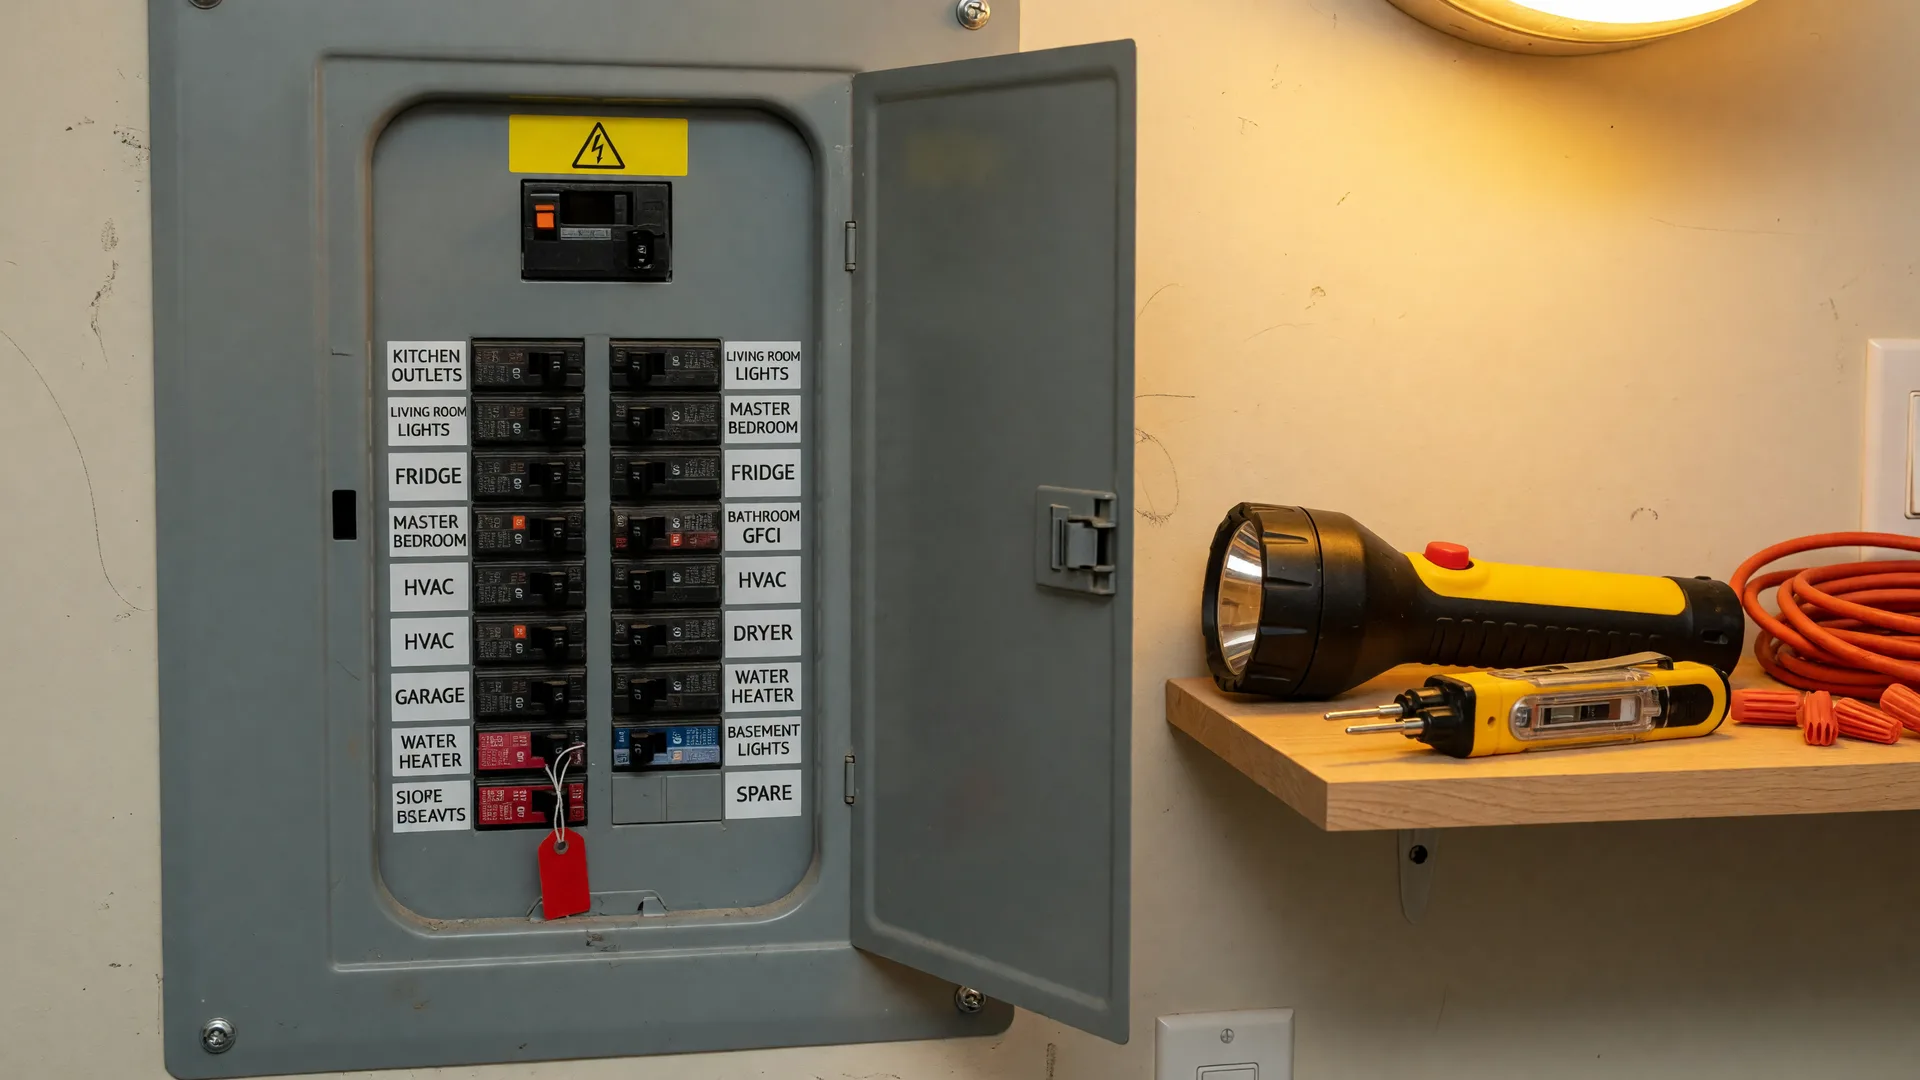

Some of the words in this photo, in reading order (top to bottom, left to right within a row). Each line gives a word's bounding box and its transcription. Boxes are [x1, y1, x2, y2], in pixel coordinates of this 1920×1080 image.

[394, 350, 459, 363] KITCHEN
[727, 351, 764, 361] LIVING
[768, 351, 801, 361] ROOM
[392, 368, 462, 382] OUTLETS
[736, 367, 788, 380] LIGHTS
[391, 407, 430, 417] LIVING
[434, 407, 467, 417] ROOM
[731, 402, 790, 415] MASTER
[399, 423, 449, 436] LIGHTS
[729, 421, 797, 434] BEDROOM
[396, 468, 461, 484] FRIDGE
[732, 464, 794, 480] FRIDGE
[394, 515, 458, 529] MASTER
[728, 511, 800, 522] BATHROOM
[394, 534, 466, 548] BEDROOM
[743, 528, 780, 543] GFCI
[405, 578, 454, 595] HVAC
[739, 571, 786, 588] HVAC
[734, 624, 793, 641] DRYER
[405, 632, 454, 650] HVAC
[735, 669, 789, 684] WATER
[395, 687, 465, 705] GARAGE
[732, 688, 794, 703] HEATER
[728, 724, 801, 738] BASEMENT
[401, 734, 456, 749] WATER
[738, 742, 789, 756] LIGHTS
[400, 753, 462, 769] HEATER
[737, 785, 792, 802] SPARE
